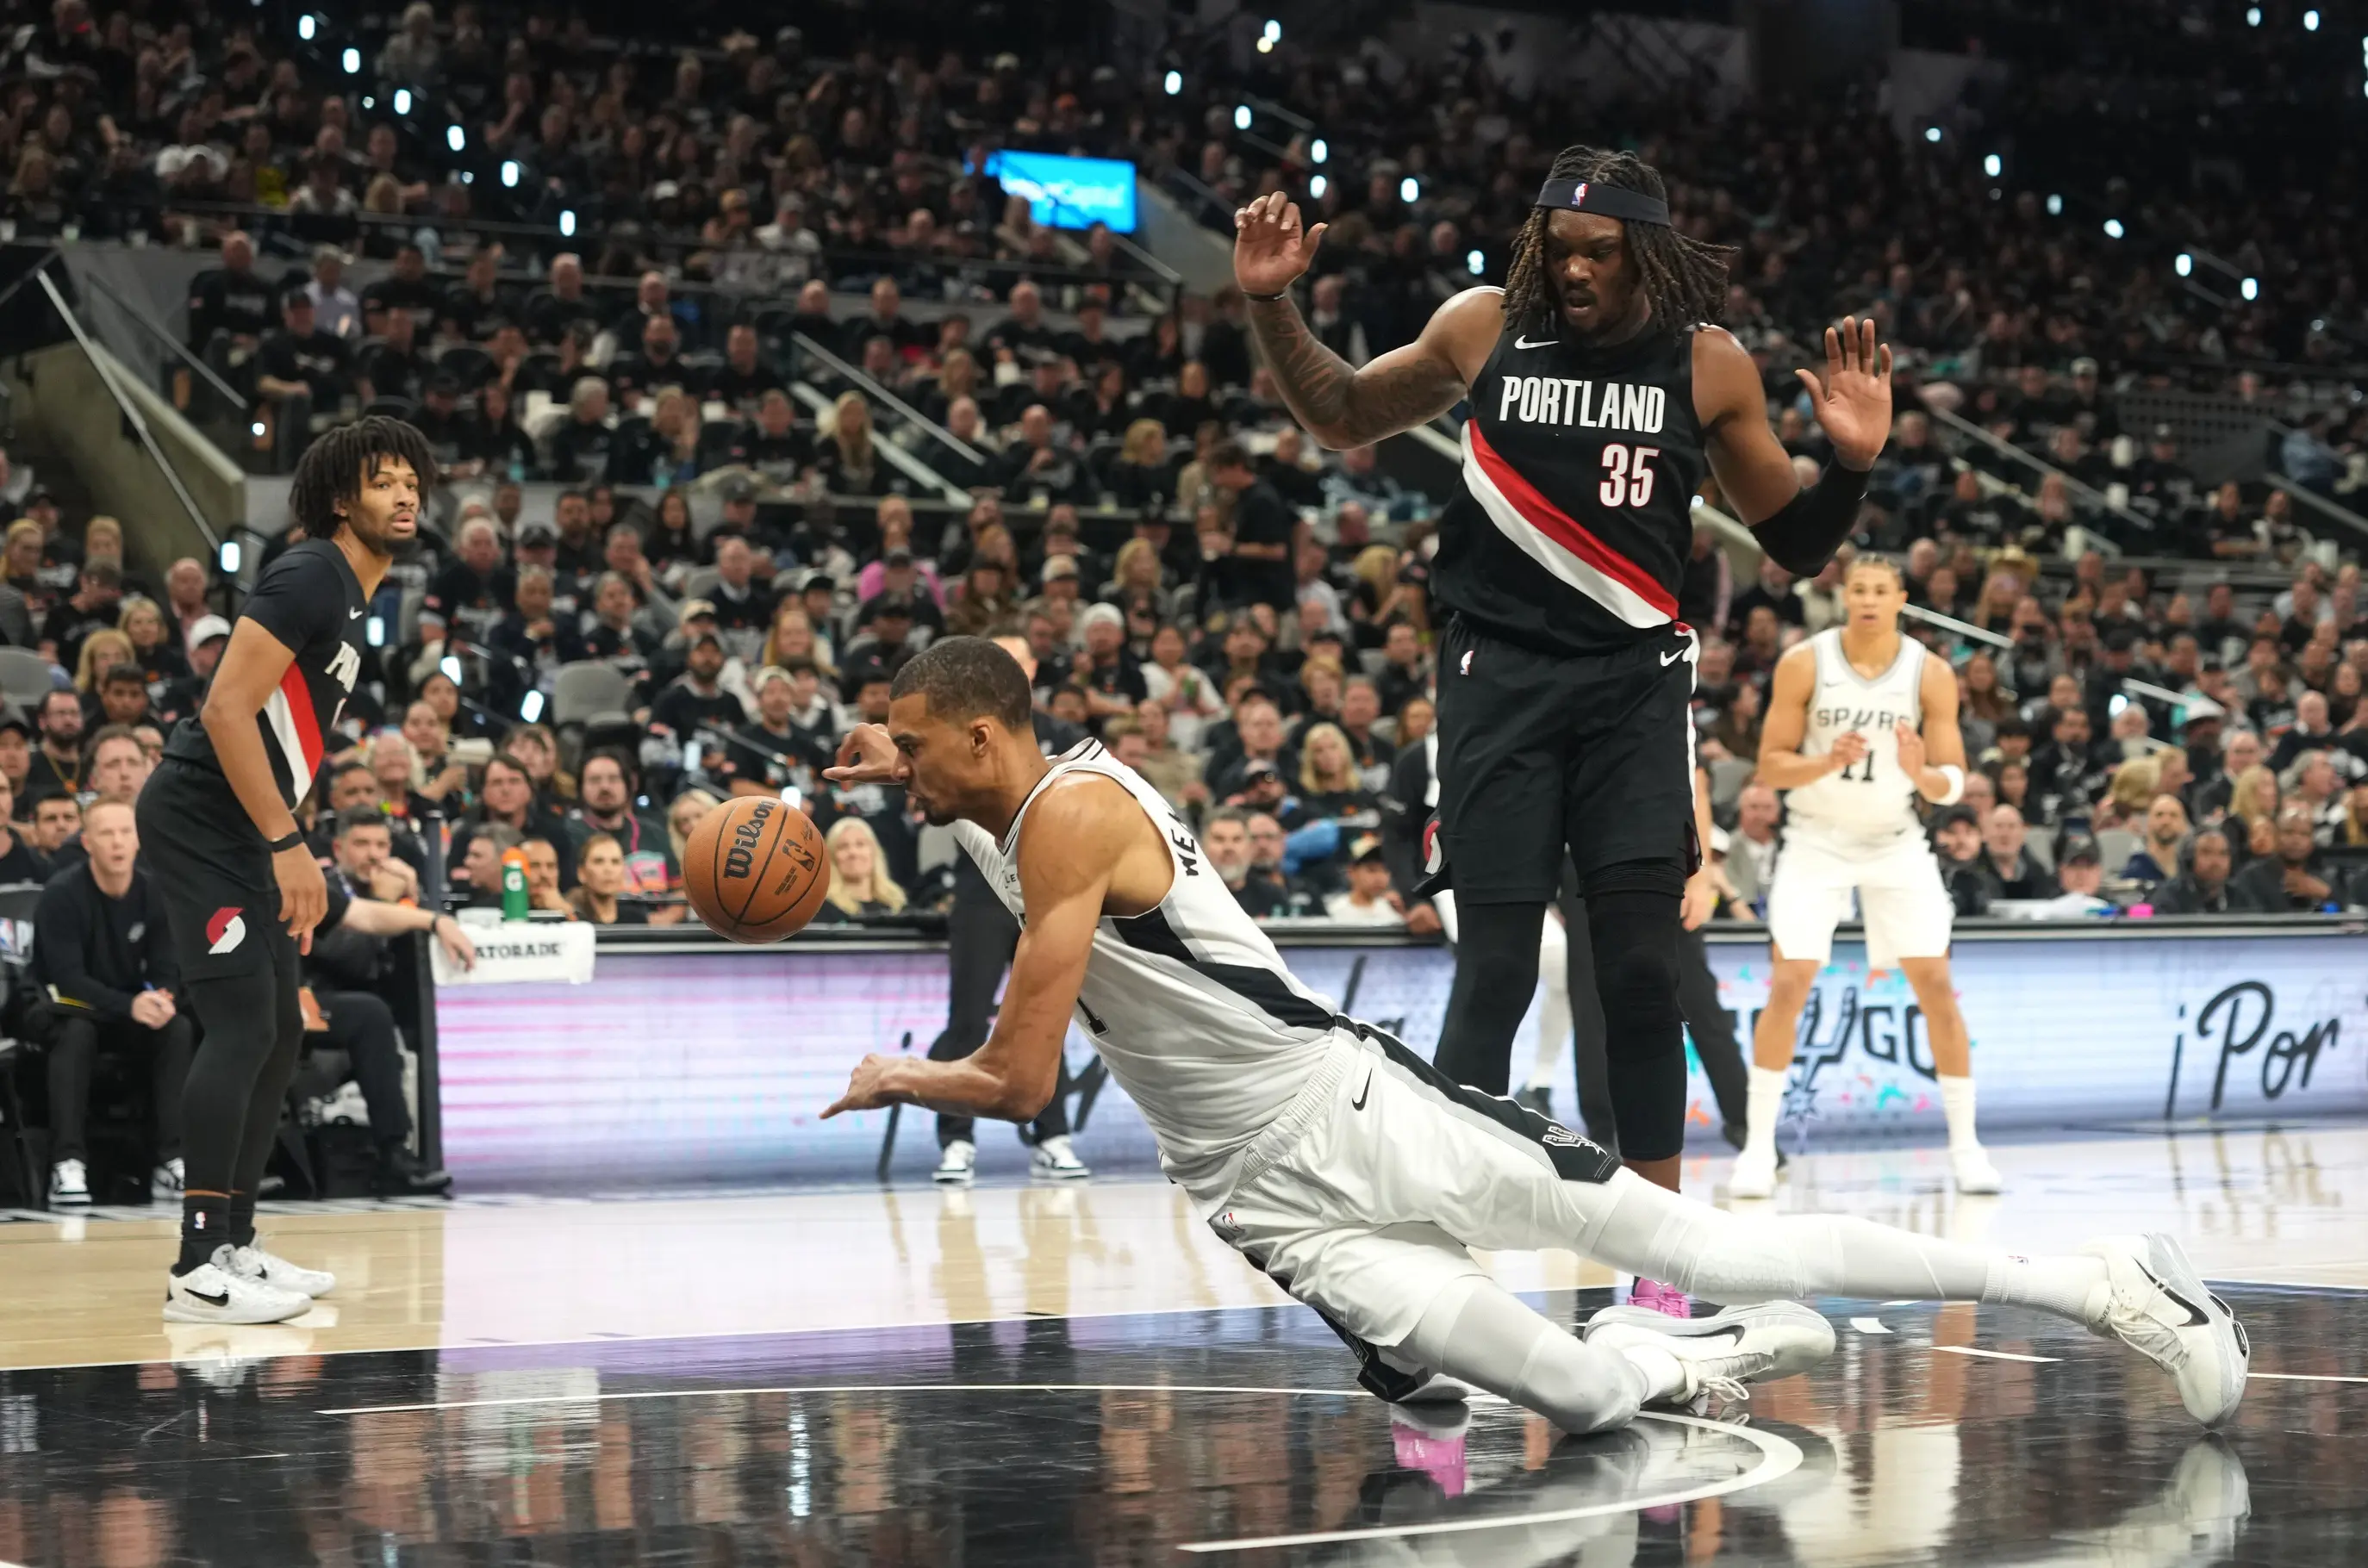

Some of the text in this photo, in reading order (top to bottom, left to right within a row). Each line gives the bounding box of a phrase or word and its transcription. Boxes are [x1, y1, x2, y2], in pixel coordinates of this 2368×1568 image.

[1499, 376, 1666, 433] PORTLAND
[1599, 442, 1661, 507] 35
[724, 800, 780, 879] Wilson
[474, 943, 562, 959] ATORADE
